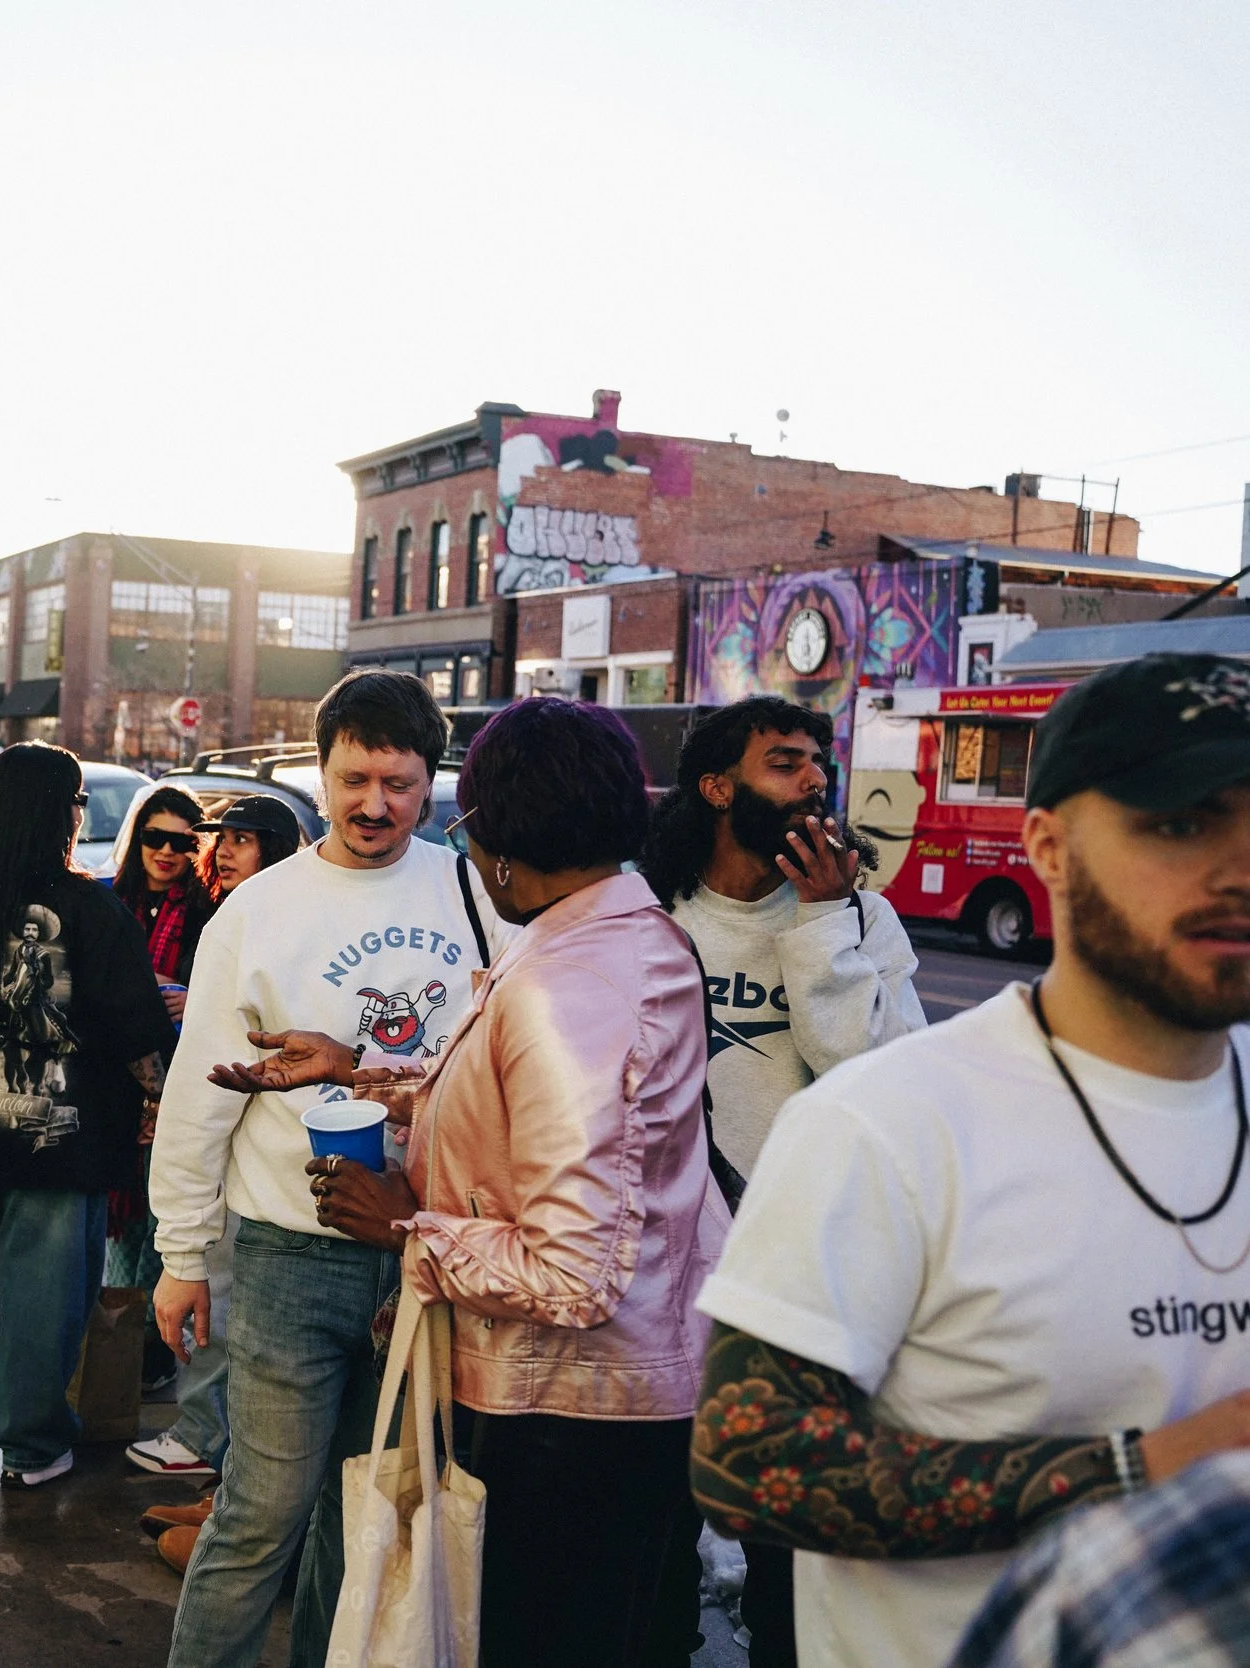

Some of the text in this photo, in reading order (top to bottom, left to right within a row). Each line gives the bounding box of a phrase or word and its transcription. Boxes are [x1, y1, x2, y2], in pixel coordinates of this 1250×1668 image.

[1010, 694, 1027, 708] Next
[917, 840, 943, 858] Follow
[322, 926, 462, 988] NUGGETS
